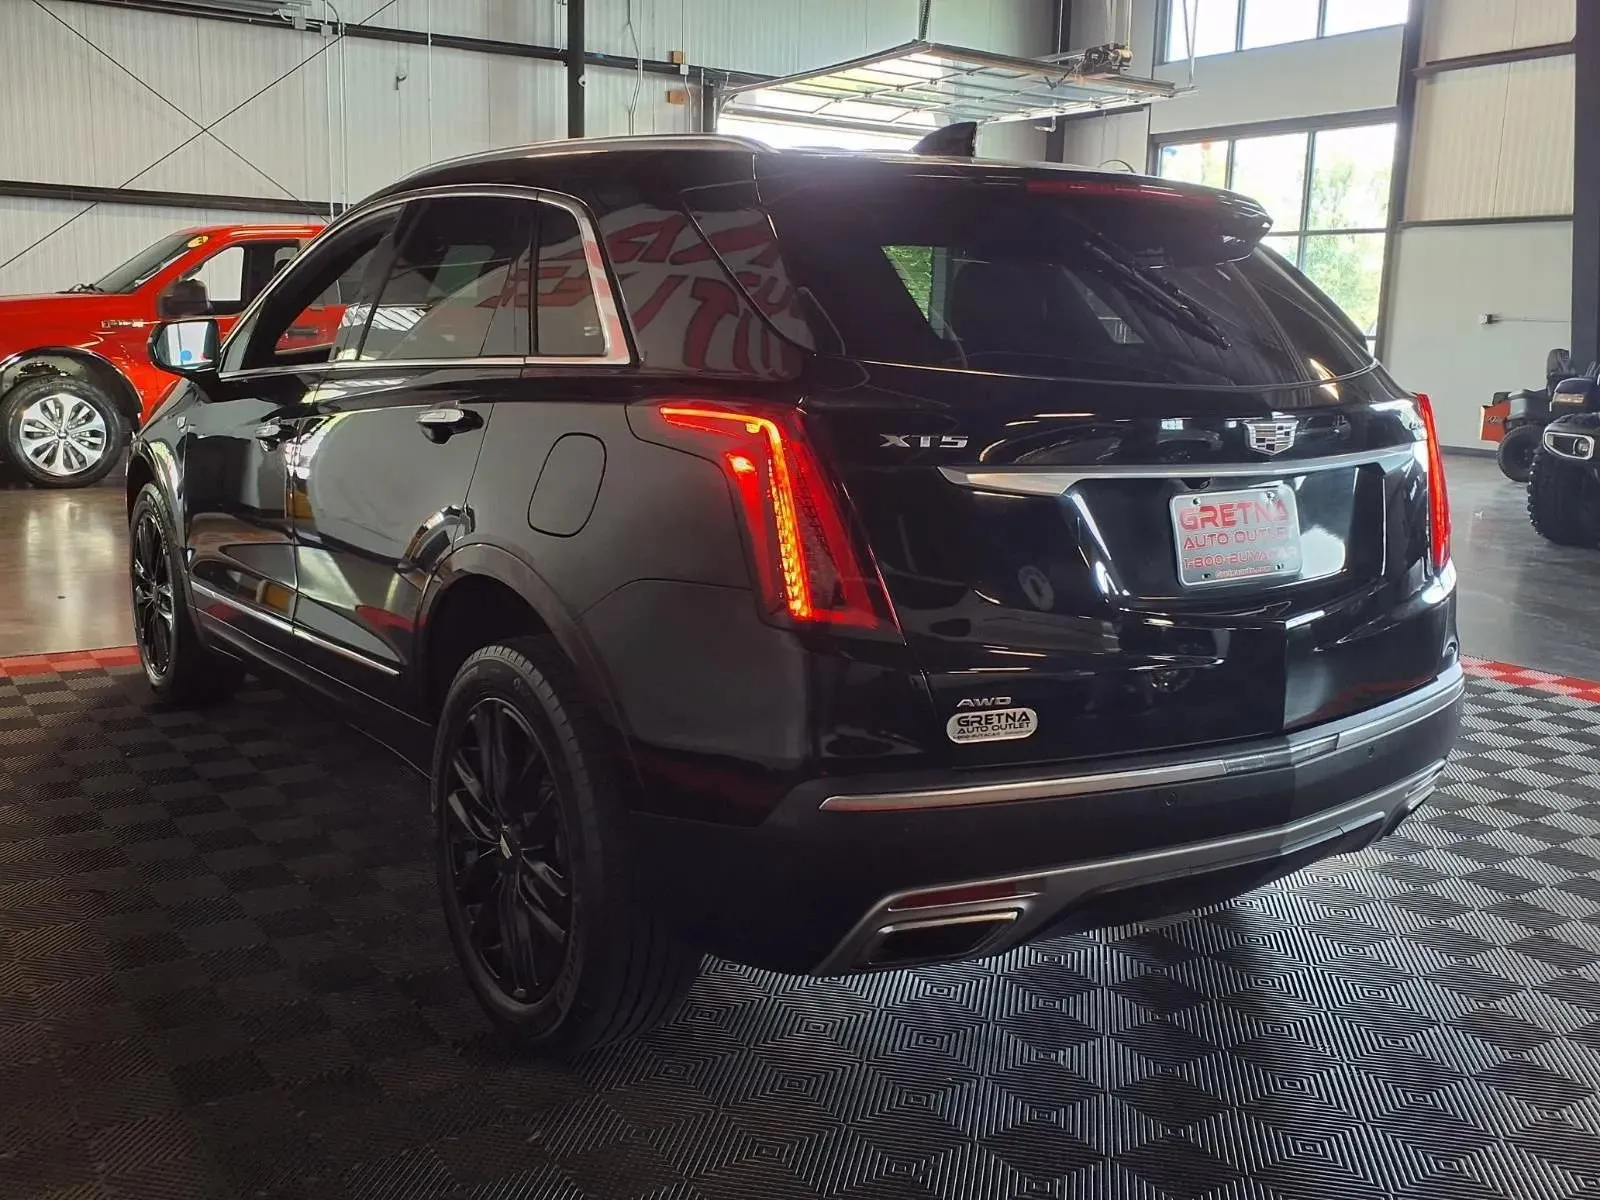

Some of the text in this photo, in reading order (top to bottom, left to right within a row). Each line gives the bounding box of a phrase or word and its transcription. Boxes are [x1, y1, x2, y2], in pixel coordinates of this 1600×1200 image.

[880, 433, 969, 448] XT5
[1179, 499, 1289, 530] GRETNA
[1184, 525, 1296, 550] AUTO OUTET
[956, 696, 1012, 707] AWD
[957, 711, 1031, 727] GRETNA
[957, 722, 1030, 735] AUTO OUTLET
